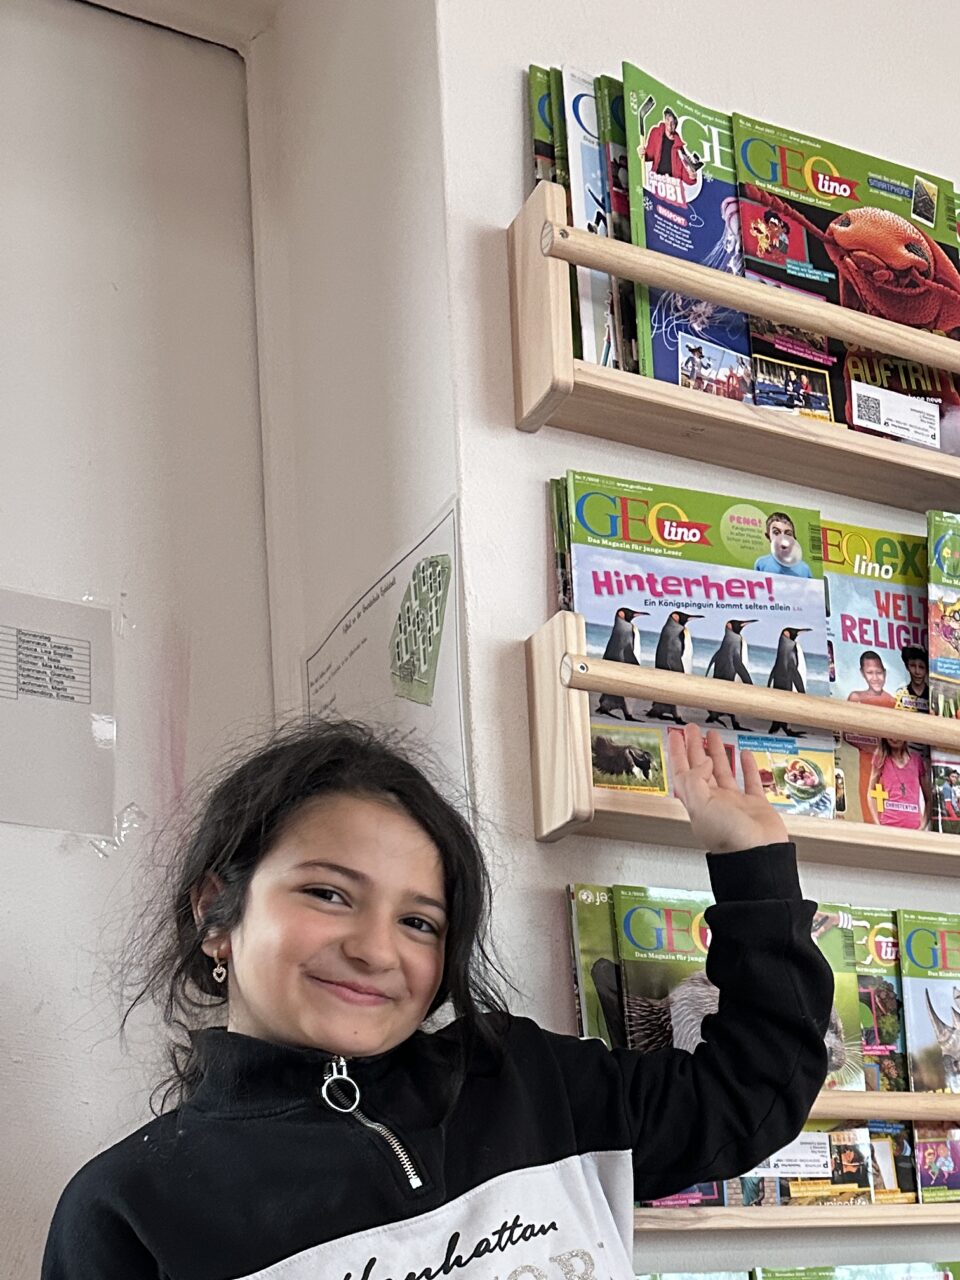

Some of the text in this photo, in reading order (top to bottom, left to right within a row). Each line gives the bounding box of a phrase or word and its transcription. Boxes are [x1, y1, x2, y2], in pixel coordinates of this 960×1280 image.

[677, 116, 736, 172] GE
[740, 138, 840, 200] GEO
[649, 179, 685, 204] TOBI
[767, 182, 790, 195] Magazin
[817, 173, 851, 197] lino
[575, 491, 689, 548] GEO
[663, 521, 701, 543] lino
[587, 536, 601, 545] Das
[601, 538, 631, 550] Magazin
[643, 545, 662, 555] junge
[663, 548, 683, 557] Leser
[821, 527, 872, 568] EO
[853, 554, 893, 579] lino
[591, 570, 775, 602] Hinterher!
[644, 599, 791, 611] Ein Königspinguin kommt selten allein
[648, 952, 675, 960] Magazin
